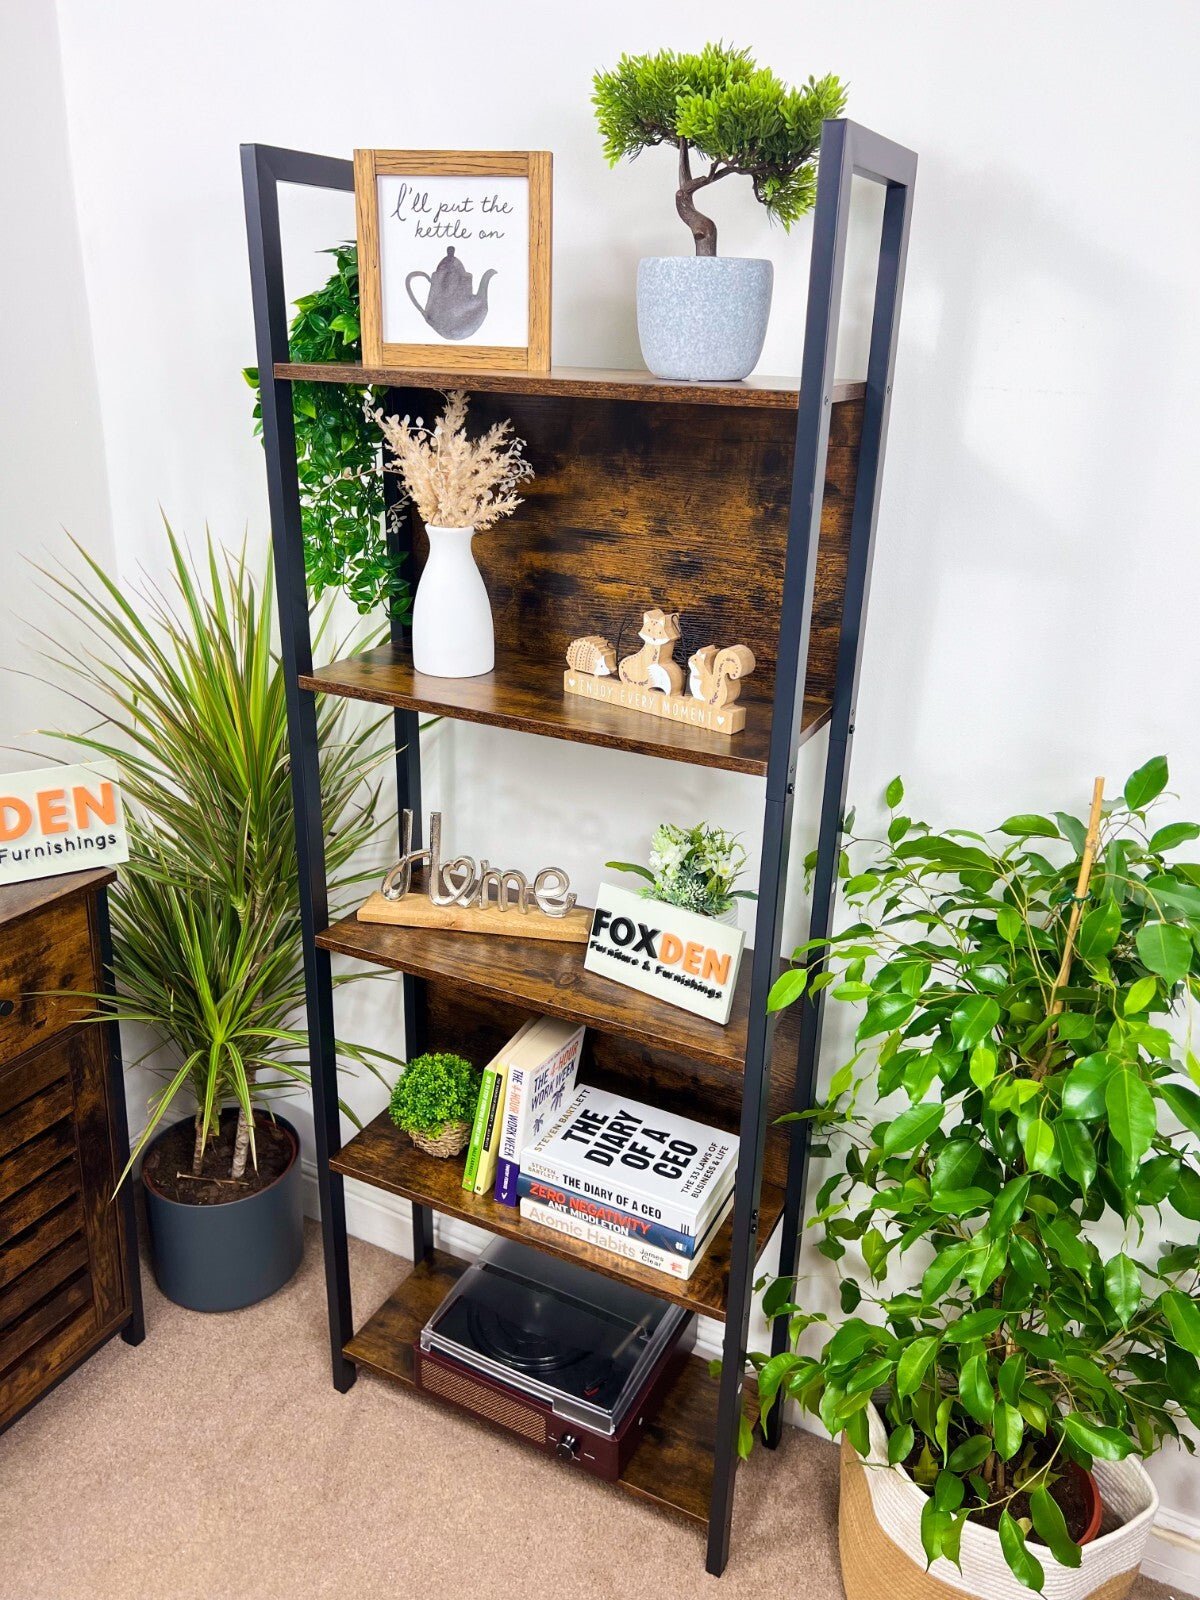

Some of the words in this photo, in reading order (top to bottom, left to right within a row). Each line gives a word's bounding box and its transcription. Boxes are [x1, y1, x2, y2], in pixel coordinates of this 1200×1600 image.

[390, 183, 432, 222] I'll
[434, 197, 474, 223] put
[480, 194, 514, 214] the
[414, 219, 473, 239] kettle
[479, 229, 505, 239] on
[578, 679, 613, 698] ENJOY
[620, 692, 654, 709] EVERY
[662, 701, 712, 725] MOMENT
[0, 782, 117, 844] DEN
[589, 940, 639, 966] Furniture
[642, 960, 651, 972] &
[655, 965, 723, 999] Furnishings
[512, 1069, 523, 1085] THE
[531, 1080, 554, 1112] WORK
[556, 1057, 576, 1088] WEEK
[534, 1068, 549, 1093] THE
[509, 1085, 521, 1114] 4-HOUR
[506, 1114, 518, 1136] WORK
[534, 1123, 562, 1152] STEVEN
[559, 1088, 591, 1124] BARTLETT
[561, 1109, 609, 1145] THE
[583, 1109, 643, 1167] DIARY
[504, 1134, 515, 1158] WEEK
[620, 1142, 656, 1170] OF
[641, 1127, 673, 1145] A
[652, 1140, 698, 1180] CEO
[713, 1158, 720, 1167] &
[716, 1145, 729, 1161] LIFE
[528, 1167, 559, 1180] BARTLETT
[531, 1162, 556, 1174] STEVEN
[681, 1178, 693, 1194] THE
[691, 1169, 701, 1181] 33
[698, 1151, 714, 1172] LAWS
[709, 1142, 719, 1153] OF
[691, 1164, 716, 1199] BUSINESS
[529, 1182, 566, 1204] ZERO
[569, 1196, 652, 1235] NEGATIVITY
[563, 1174, 581, 1189] THE
[584, 1182, 613, 1201] DIARY
[616, 1195, 629, 1207] OF
[632, 1201, 638, 1211] A
[641, 1203, 662, 1220] CEO
[529, 1207, 583, 1236] Atomic
[587, 1226, 636, 1257] Habits
[548, 1200, 568, 1214] ANT
[570, 1209, 630, 1237] MIDDLETON
[640, 1249, 664, 1262] James
[641, 1255, 661, 1267] Clear
